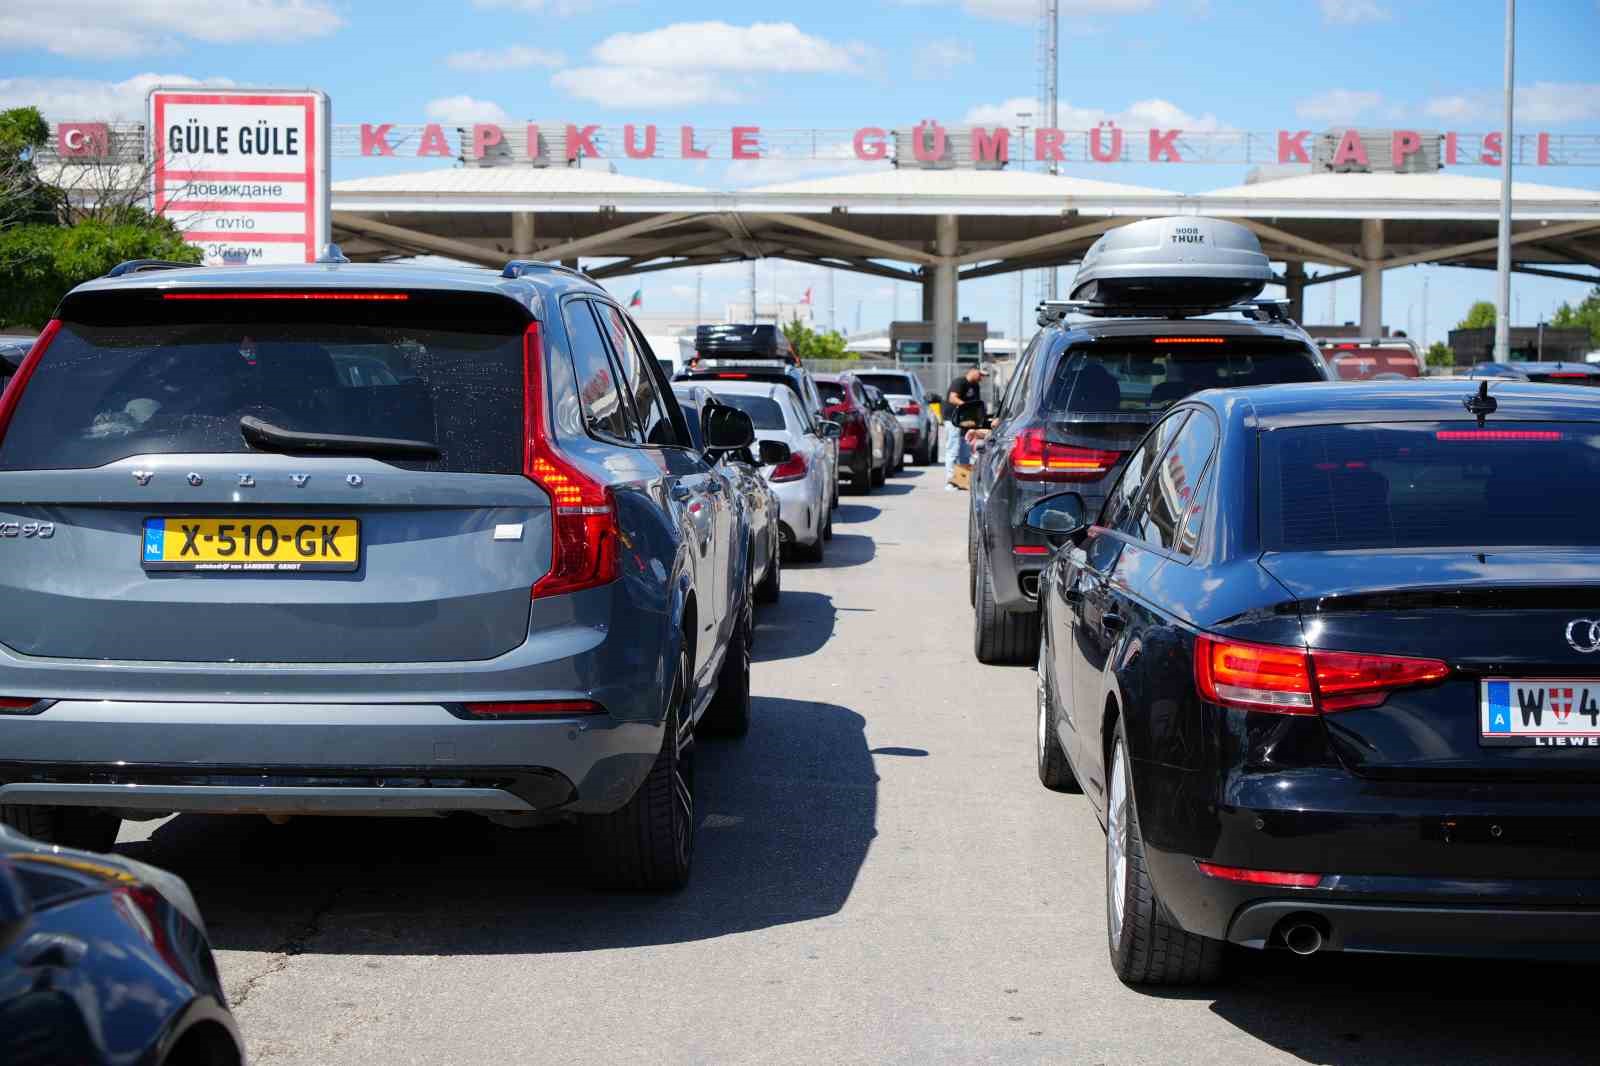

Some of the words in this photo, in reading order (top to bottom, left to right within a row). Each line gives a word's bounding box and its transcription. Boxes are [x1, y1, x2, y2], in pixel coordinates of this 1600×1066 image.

[168, 118, 229, 155] GÜLE
[238, 120, 299, 156] GÜLE
[360, 123, 762, 161] KAPIKULE
[852, 119, 1184, 163] GÜMRÜK
[1277, 128, 1550, 166] KAPISI
[1171, 235, 1205, 244] THULE
[131, 471, 363, 488] VOLVO
[146, 543, 161, 555] NL
[180, 523, 342, 557] X-510-GK
[1494, 713, 1505, 725] A
[1517, 687, 1545, 727] W
[1579, 687, 1600, 727] 4
